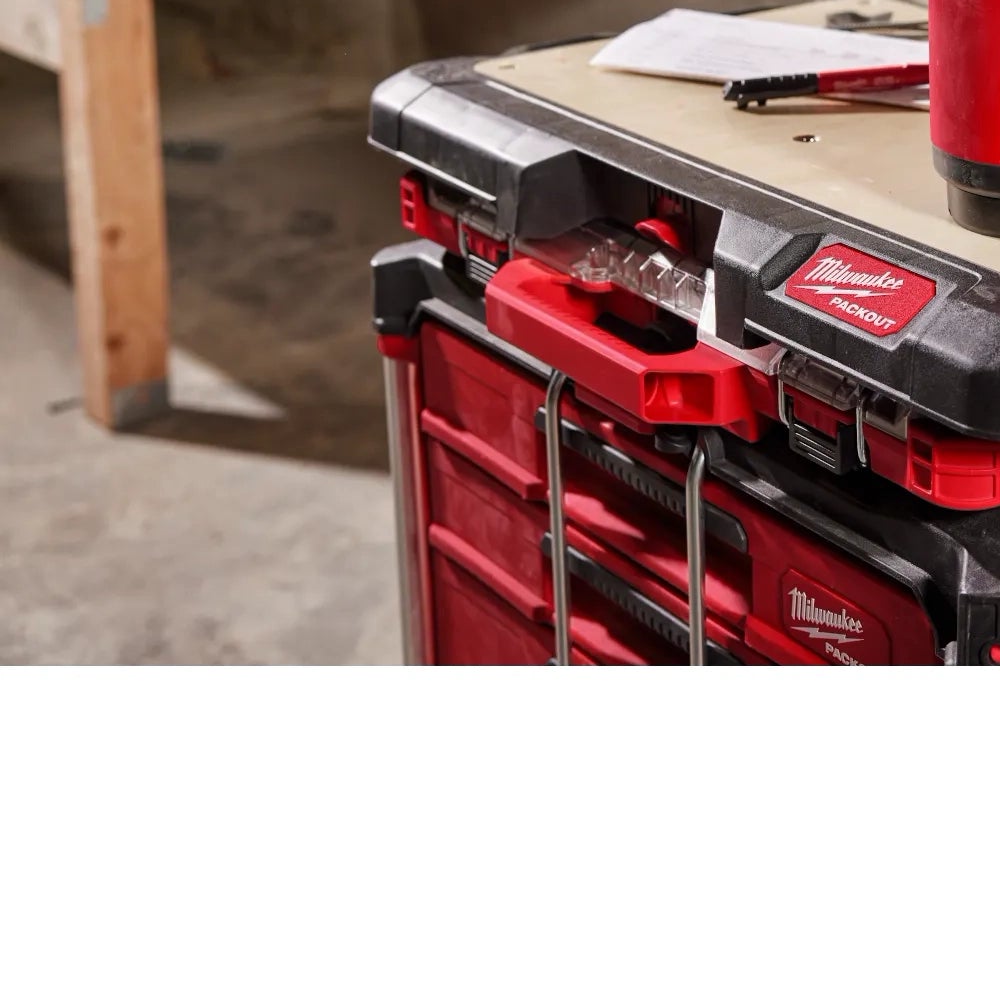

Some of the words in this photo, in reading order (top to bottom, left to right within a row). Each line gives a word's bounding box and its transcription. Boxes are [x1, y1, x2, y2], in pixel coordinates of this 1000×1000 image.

[804, 256, 904, 289] Milwaukee
[828, 297, 897, 330] PACKOUT
[787, 587, 865, 633] Milwaukee
[825, 642, 866, 666] PACK
